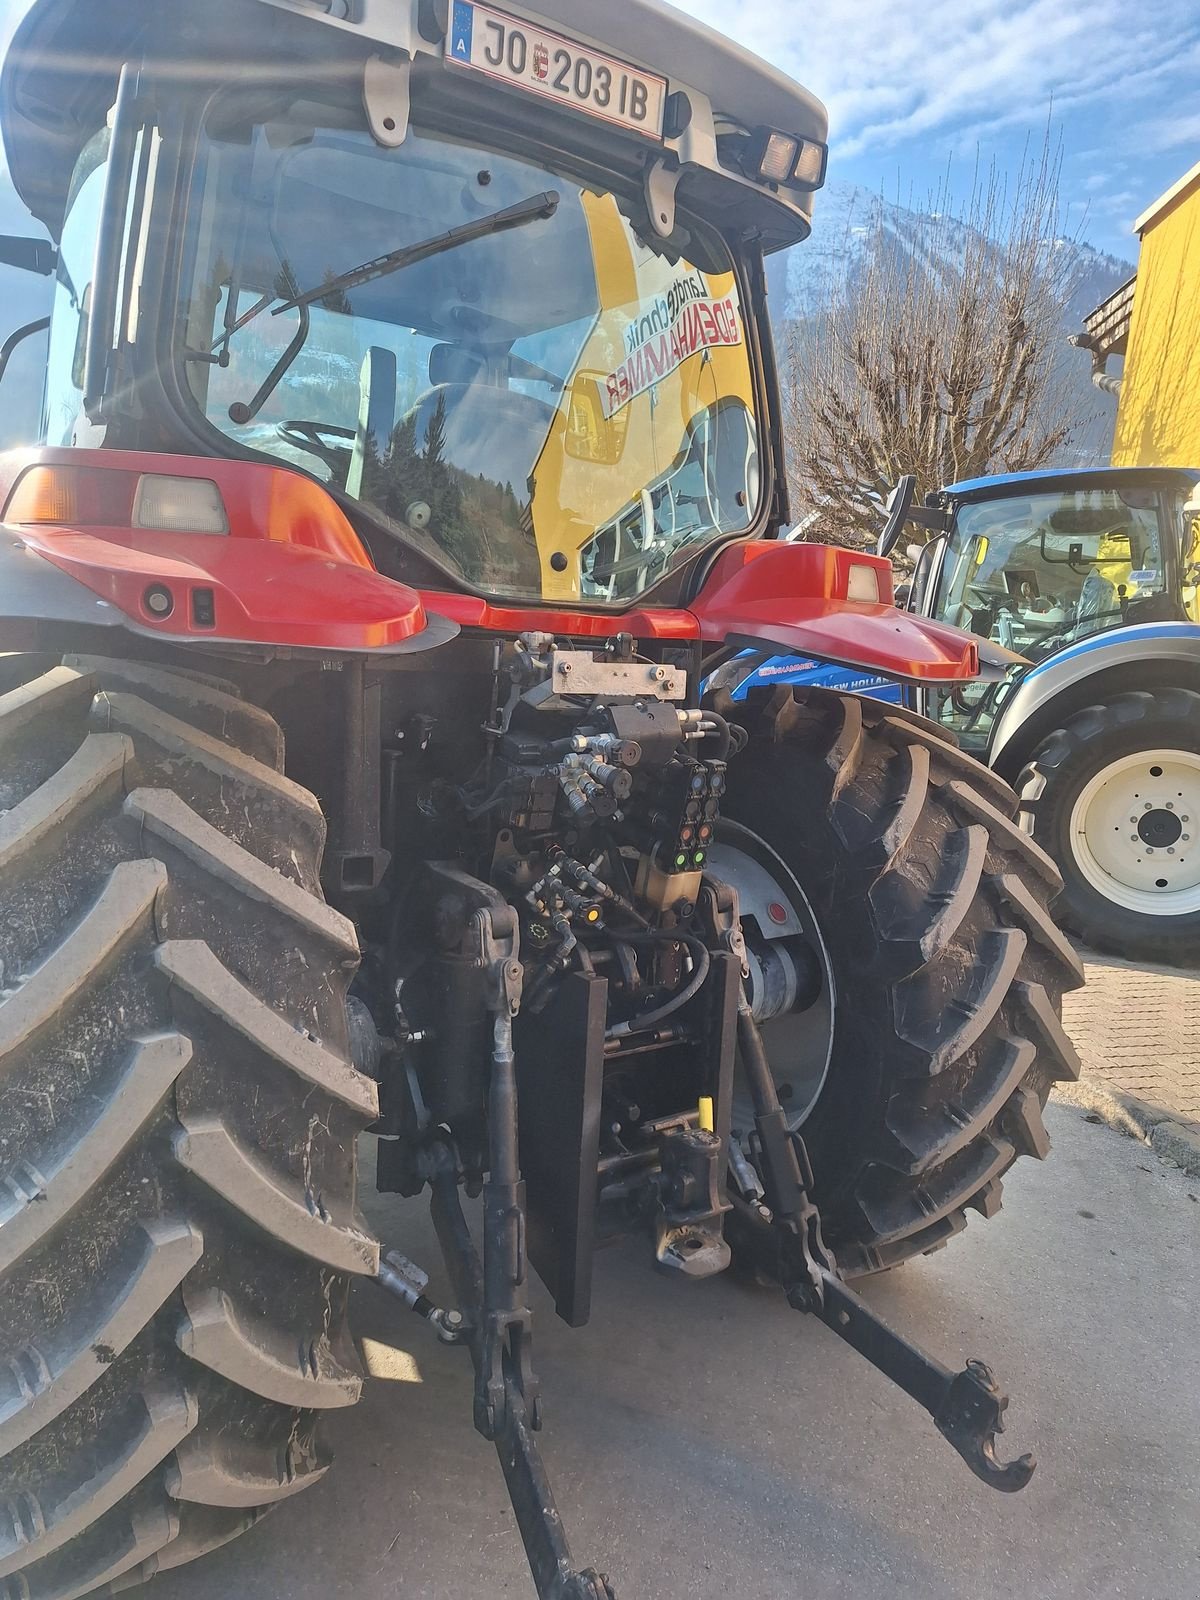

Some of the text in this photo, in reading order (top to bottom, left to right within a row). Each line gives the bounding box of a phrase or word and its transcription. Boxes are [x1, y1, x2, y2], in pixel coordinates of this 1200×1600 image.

[456, 38, 466, 53] A
[485, 20, 648, 121] JO 203 IB
